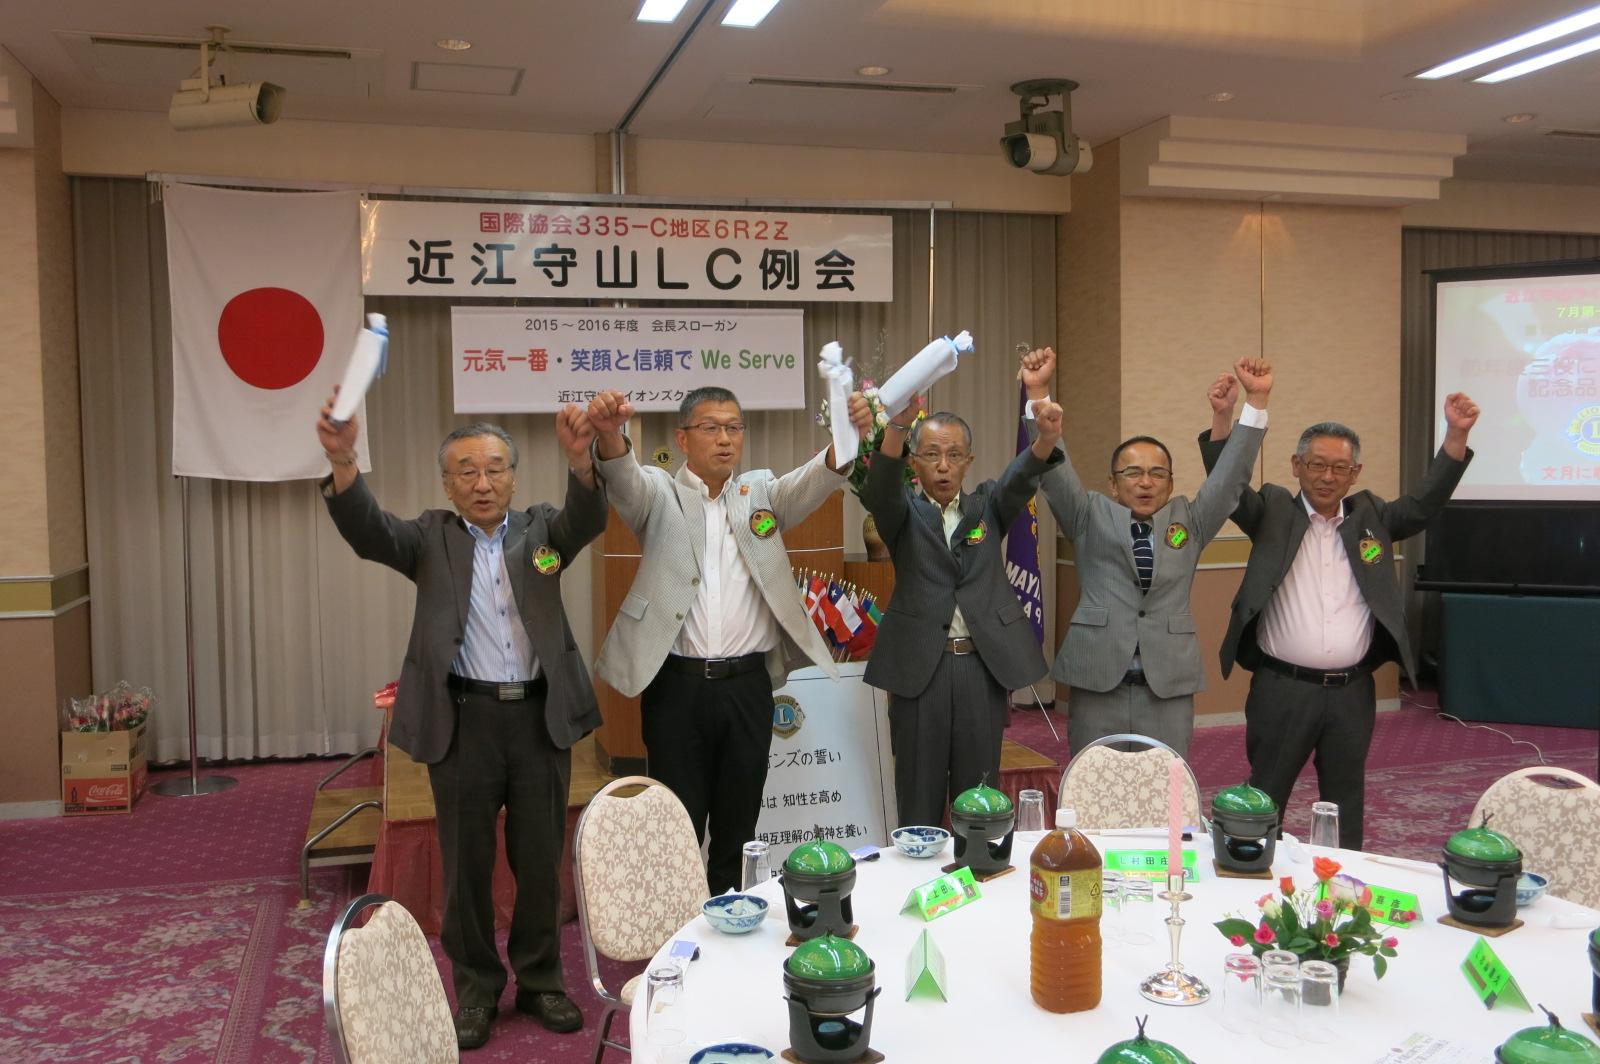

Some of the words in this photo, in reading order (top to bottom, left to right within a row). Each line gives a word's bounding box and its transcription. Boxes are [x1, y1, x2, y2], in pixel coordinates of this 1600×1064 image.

[406, 239, 856, 292] 近江守山LC例会
[651, 319, 738, 332] 会長スローガン
[701, 349, 731, 370] We
[738, 349, 796, 370] Serve
[782, 790, 842, 807] 知性を高め
